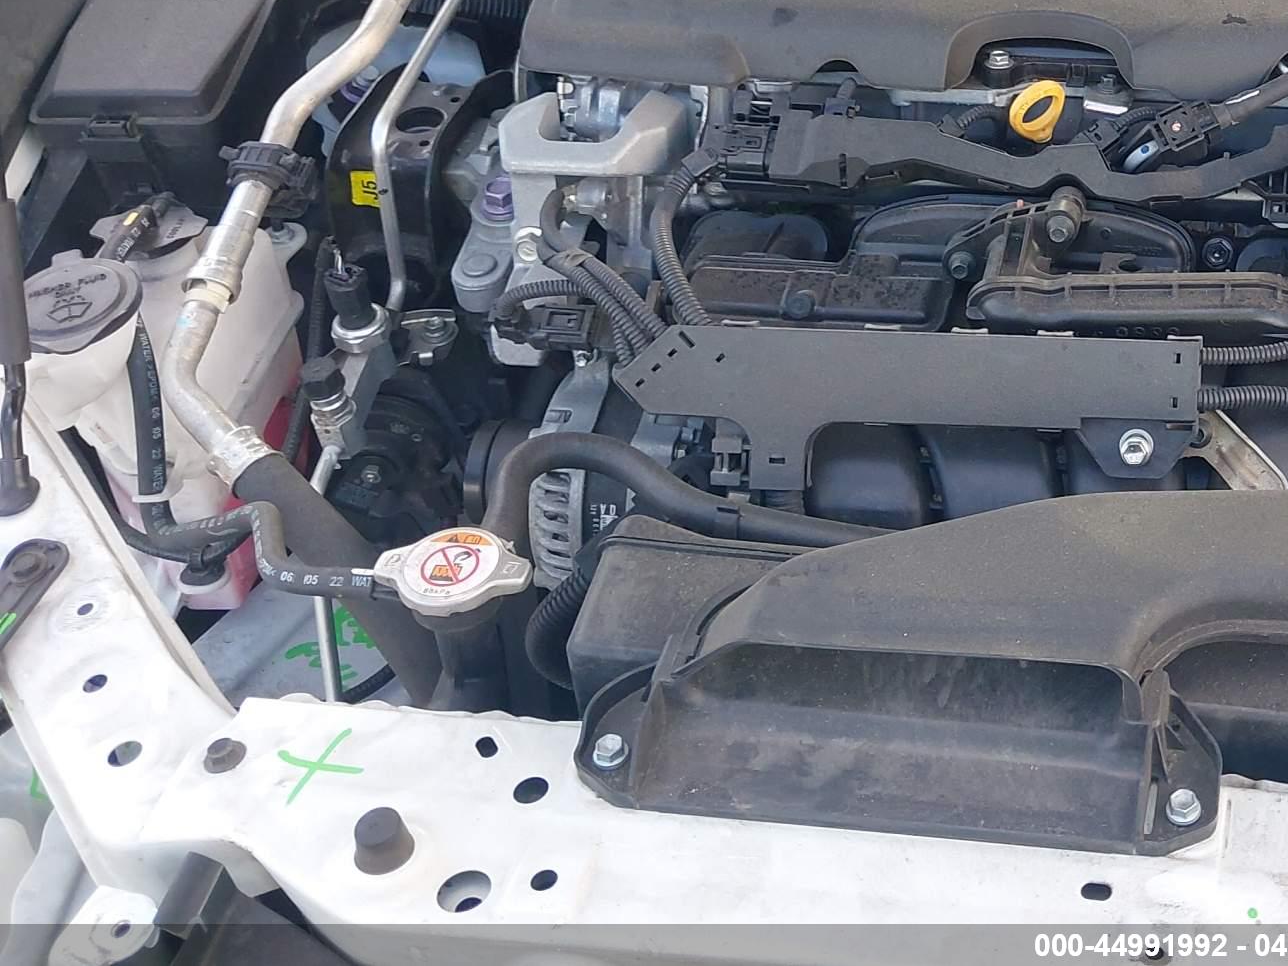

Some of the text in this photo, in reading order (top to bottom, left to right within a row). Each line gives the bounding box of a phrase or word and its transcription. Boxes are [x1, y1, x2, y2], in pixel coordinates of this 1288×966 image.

[280, 571, 294, 583] 06
[328, 576, 345, 587] 22
[351, 575, 374, 587] WAT
